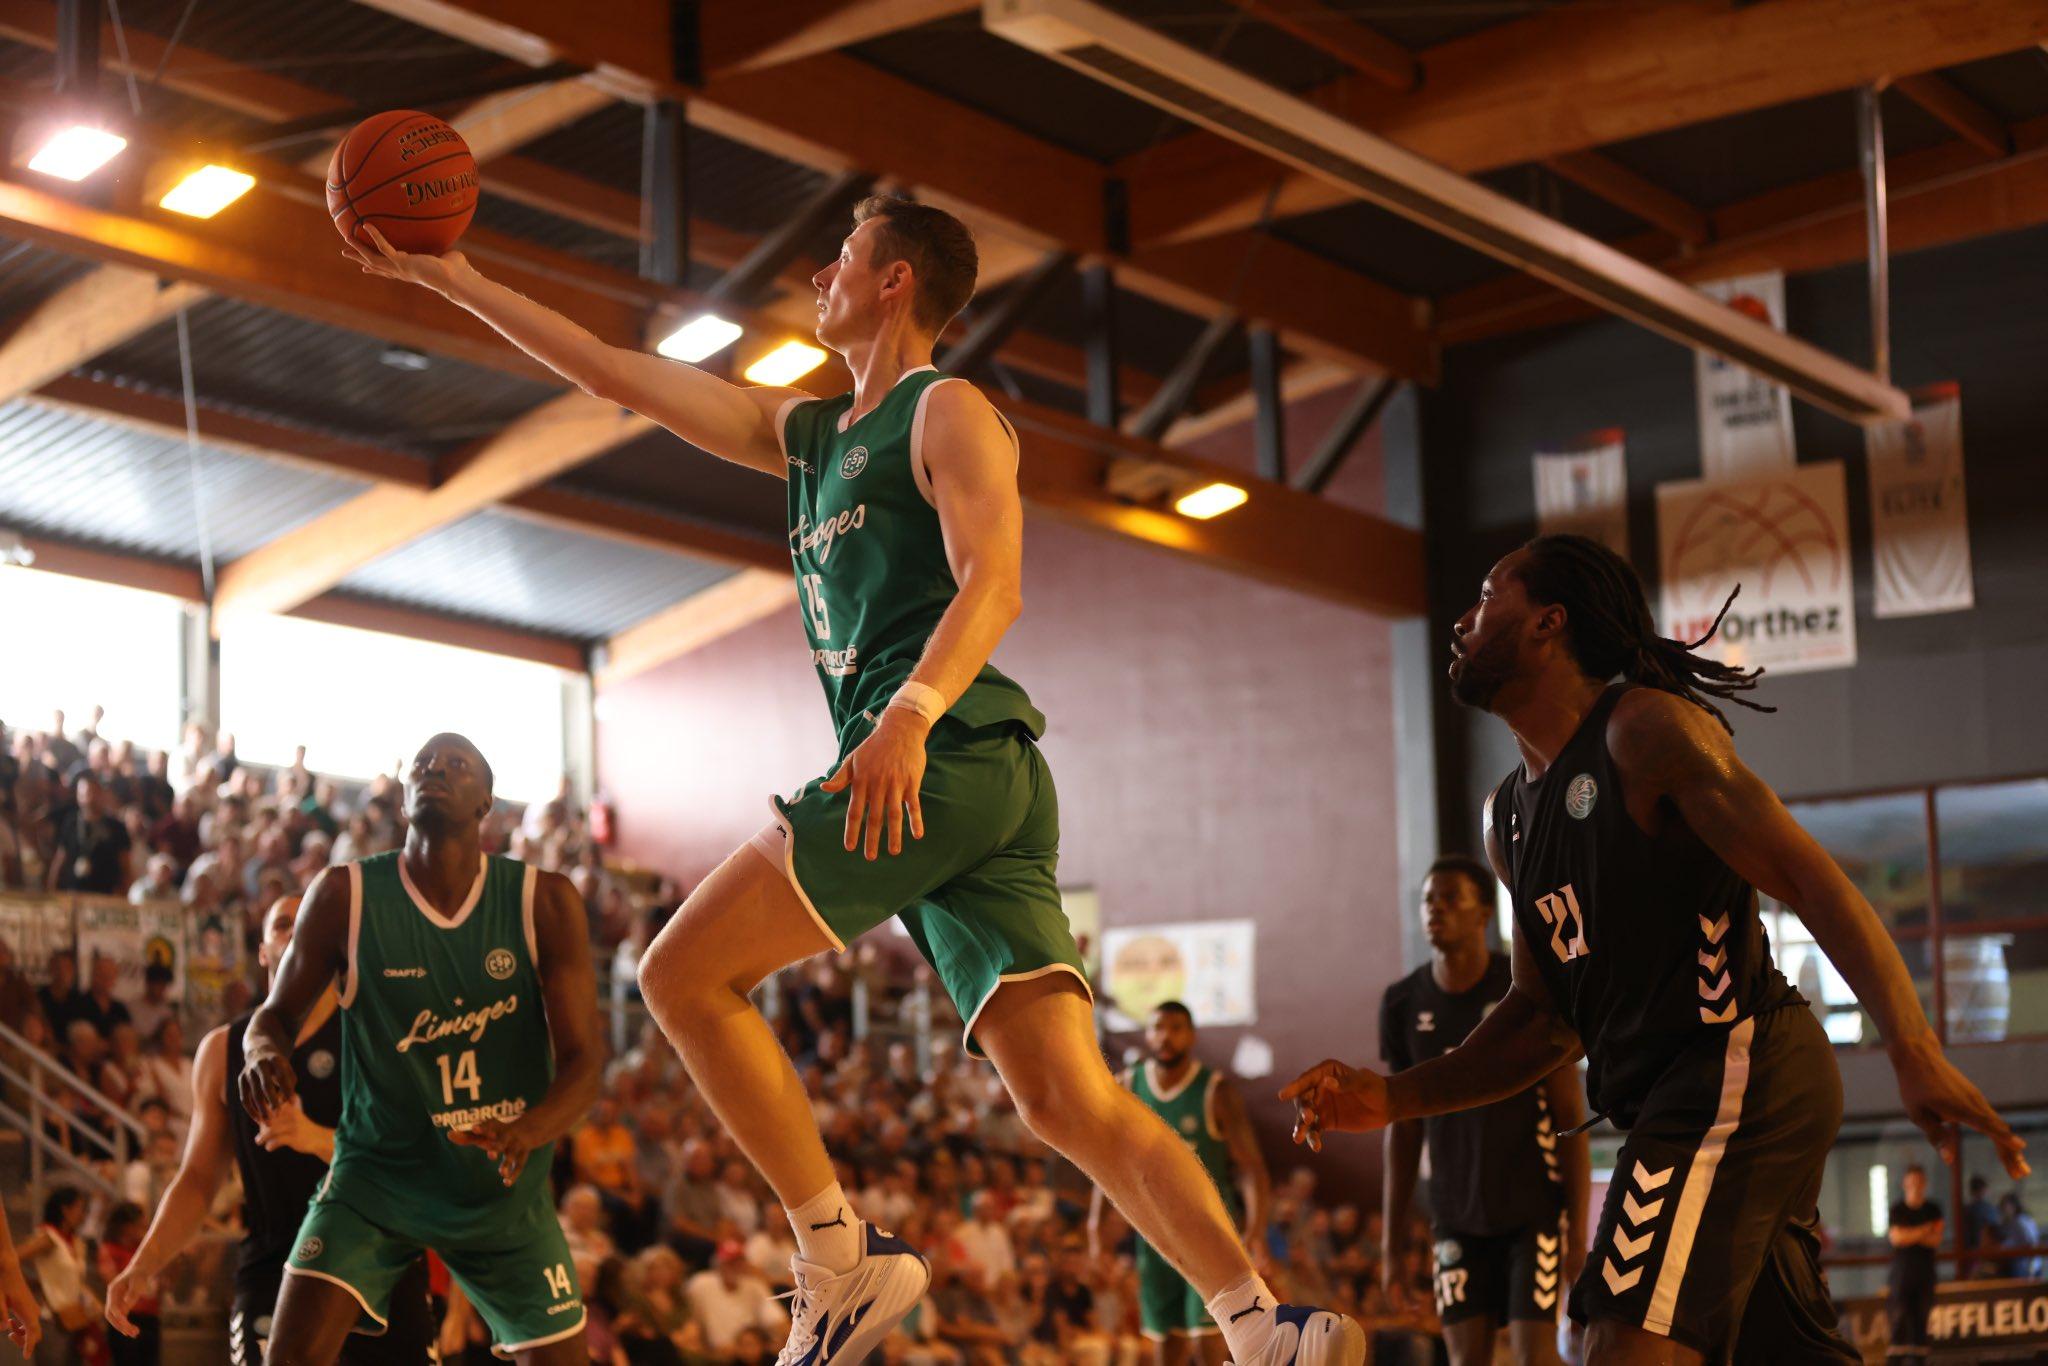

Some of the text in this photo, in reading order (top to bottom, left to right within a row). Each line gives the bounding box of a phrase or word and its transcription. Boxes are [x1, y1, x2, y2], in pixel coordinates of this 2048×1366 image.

[404, 163, 479, 208] PALDING
[803, 573, 831, 641] 15
[1534, 883, 1590, 963] 21
[383, 968, 418, 978] CRAFT
[396, 994, 518, 1053] Limoges
[436, 1050, 482, 1105] 14
[543, 1263, 572, 1300] 14
